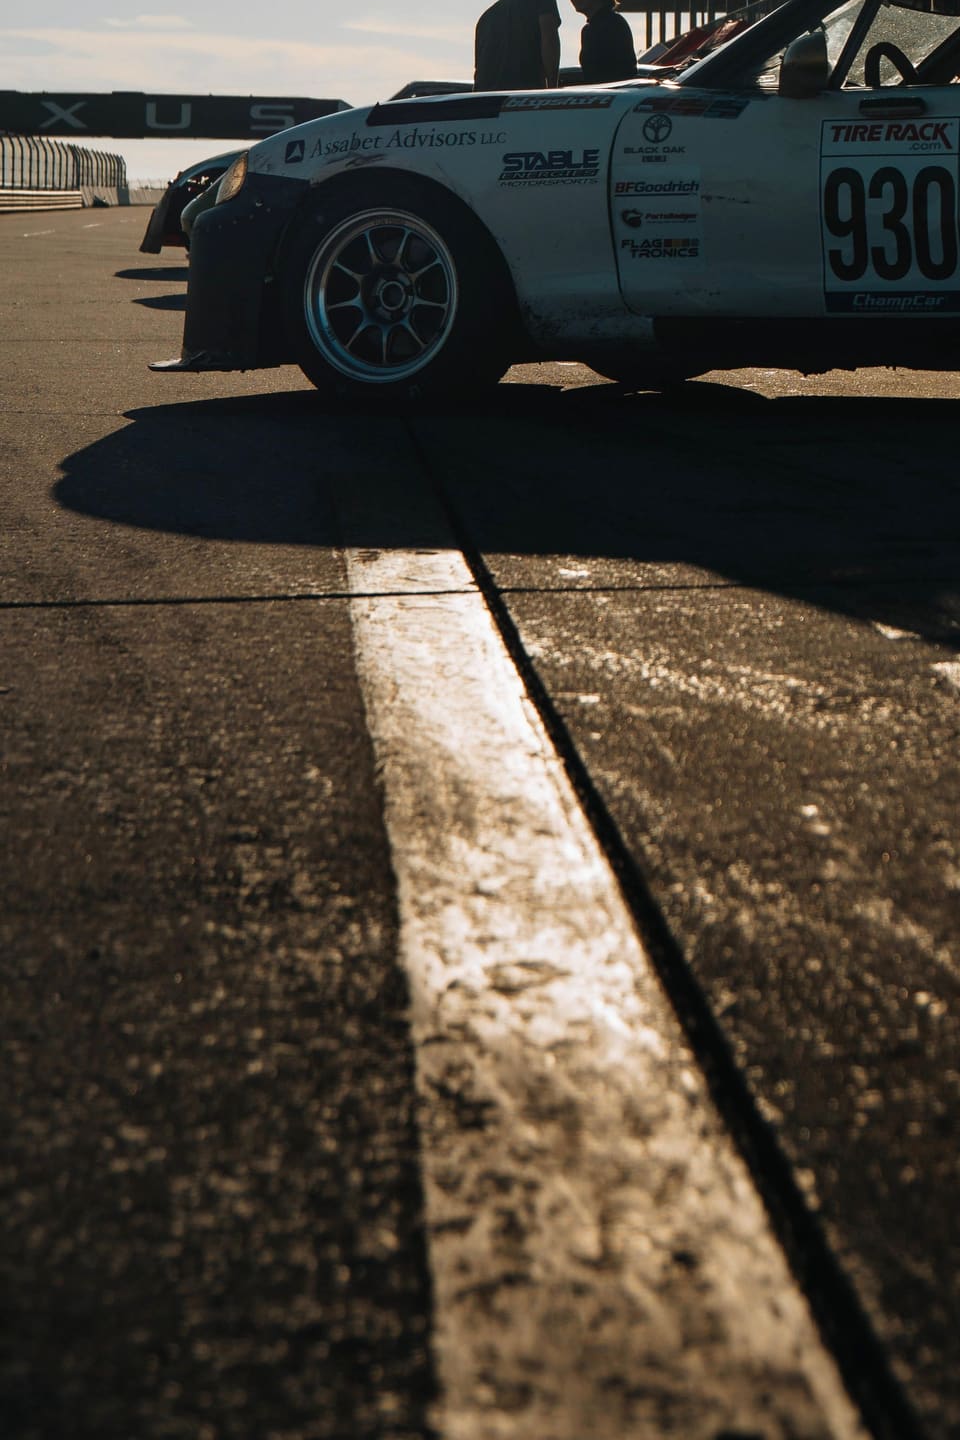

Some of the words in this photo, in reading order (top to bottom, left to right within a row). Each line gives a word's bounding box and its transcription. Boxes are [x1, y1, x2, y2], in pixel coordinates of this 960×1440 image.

[310, 132, 381, 160] Assabet
[386, 128, 477, 149] Advisors
[481, 132, 508, 144] LLC
[831, 124, 884, 142] TIRE
[884, 122, 952, 150] RACK
[623, 146, 659, 154] BLACK
[662, 145, 687, 153] OAK
[502, 149, 601, 172] STABLE
[615, 181, 700, 194] BFGoodrich
[824, 166, 959, 281] 930
[621, 239, 664, 249] FLAG
[630, 248, 700, 259] TRONICS
[852, 292, 945, 311] ChampCar
